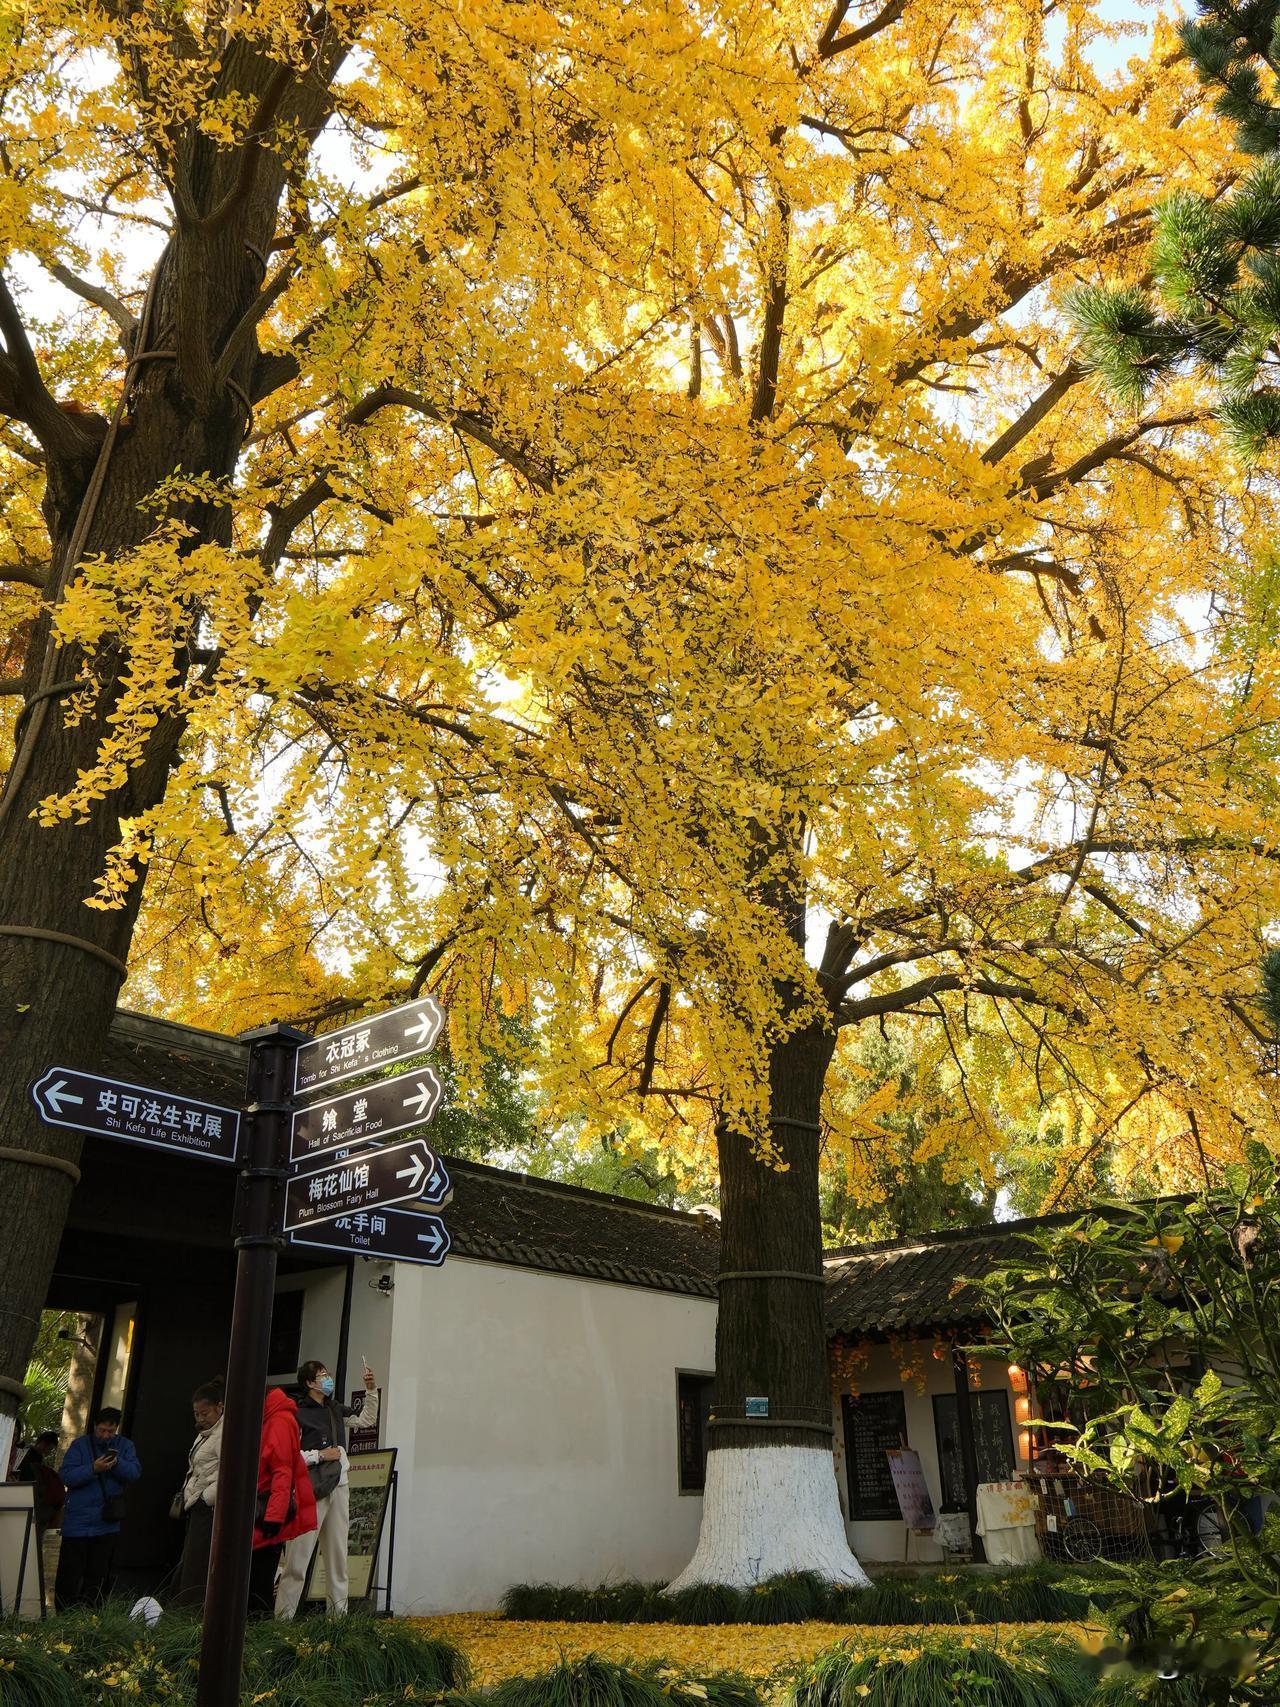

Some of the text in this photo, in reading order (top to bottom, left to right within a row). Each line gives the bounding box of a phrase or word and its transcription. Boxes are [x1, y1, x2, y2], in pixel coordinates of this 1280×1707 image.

[300, 1072, 317, 1086] Tomb
[318, 1069, 328, 1079] for
[330, 1063, 341, 1075] Shi
[372, 1044, 399, 1060] Clothing
[96, 1089, 222, 1139] 史可法生平展
[105, 1116, 211, 1148] Shi Kefa Life Exhibition
[308, 1117, 383, 1149] Hall of Sacrificial Food
[308, 1163, 370, 1202] 梅花仙馆
[298, 1188, 379, 1218] Plum Blossom Fairy Hall
[349, 1233, 371, 1246] Toilet
